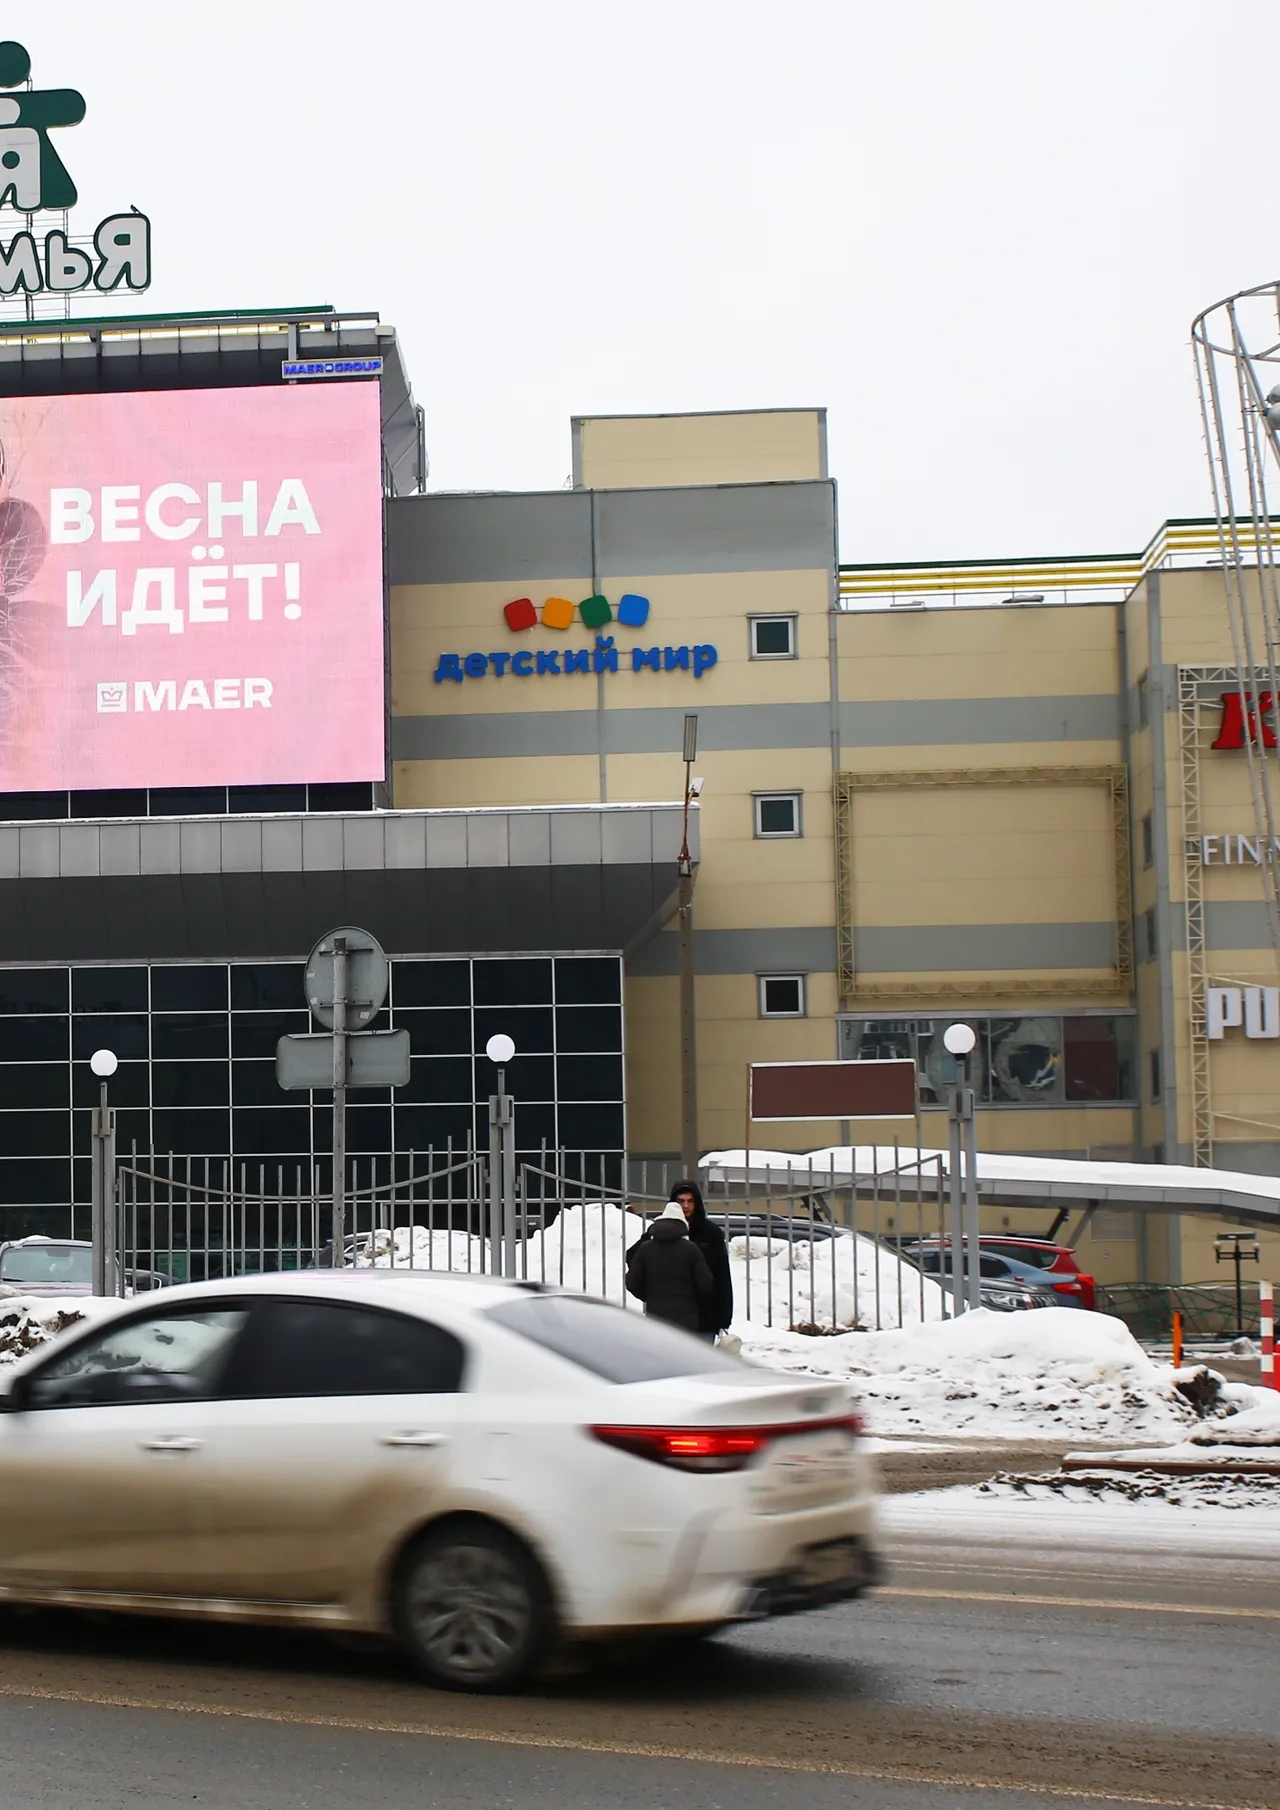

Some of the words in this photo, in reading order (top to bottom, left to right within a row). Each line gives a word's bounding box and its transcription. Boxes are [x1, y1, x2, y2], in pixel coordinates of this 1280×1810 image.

[283, 363, 324, 376] MAER
[334, 361, 382, 373] GROUP
[50, 478, 322, 545] ВЕСНА
[66, 544, 302, 635] ИДЁТ!
[134, 676, 274, 713] MAER
